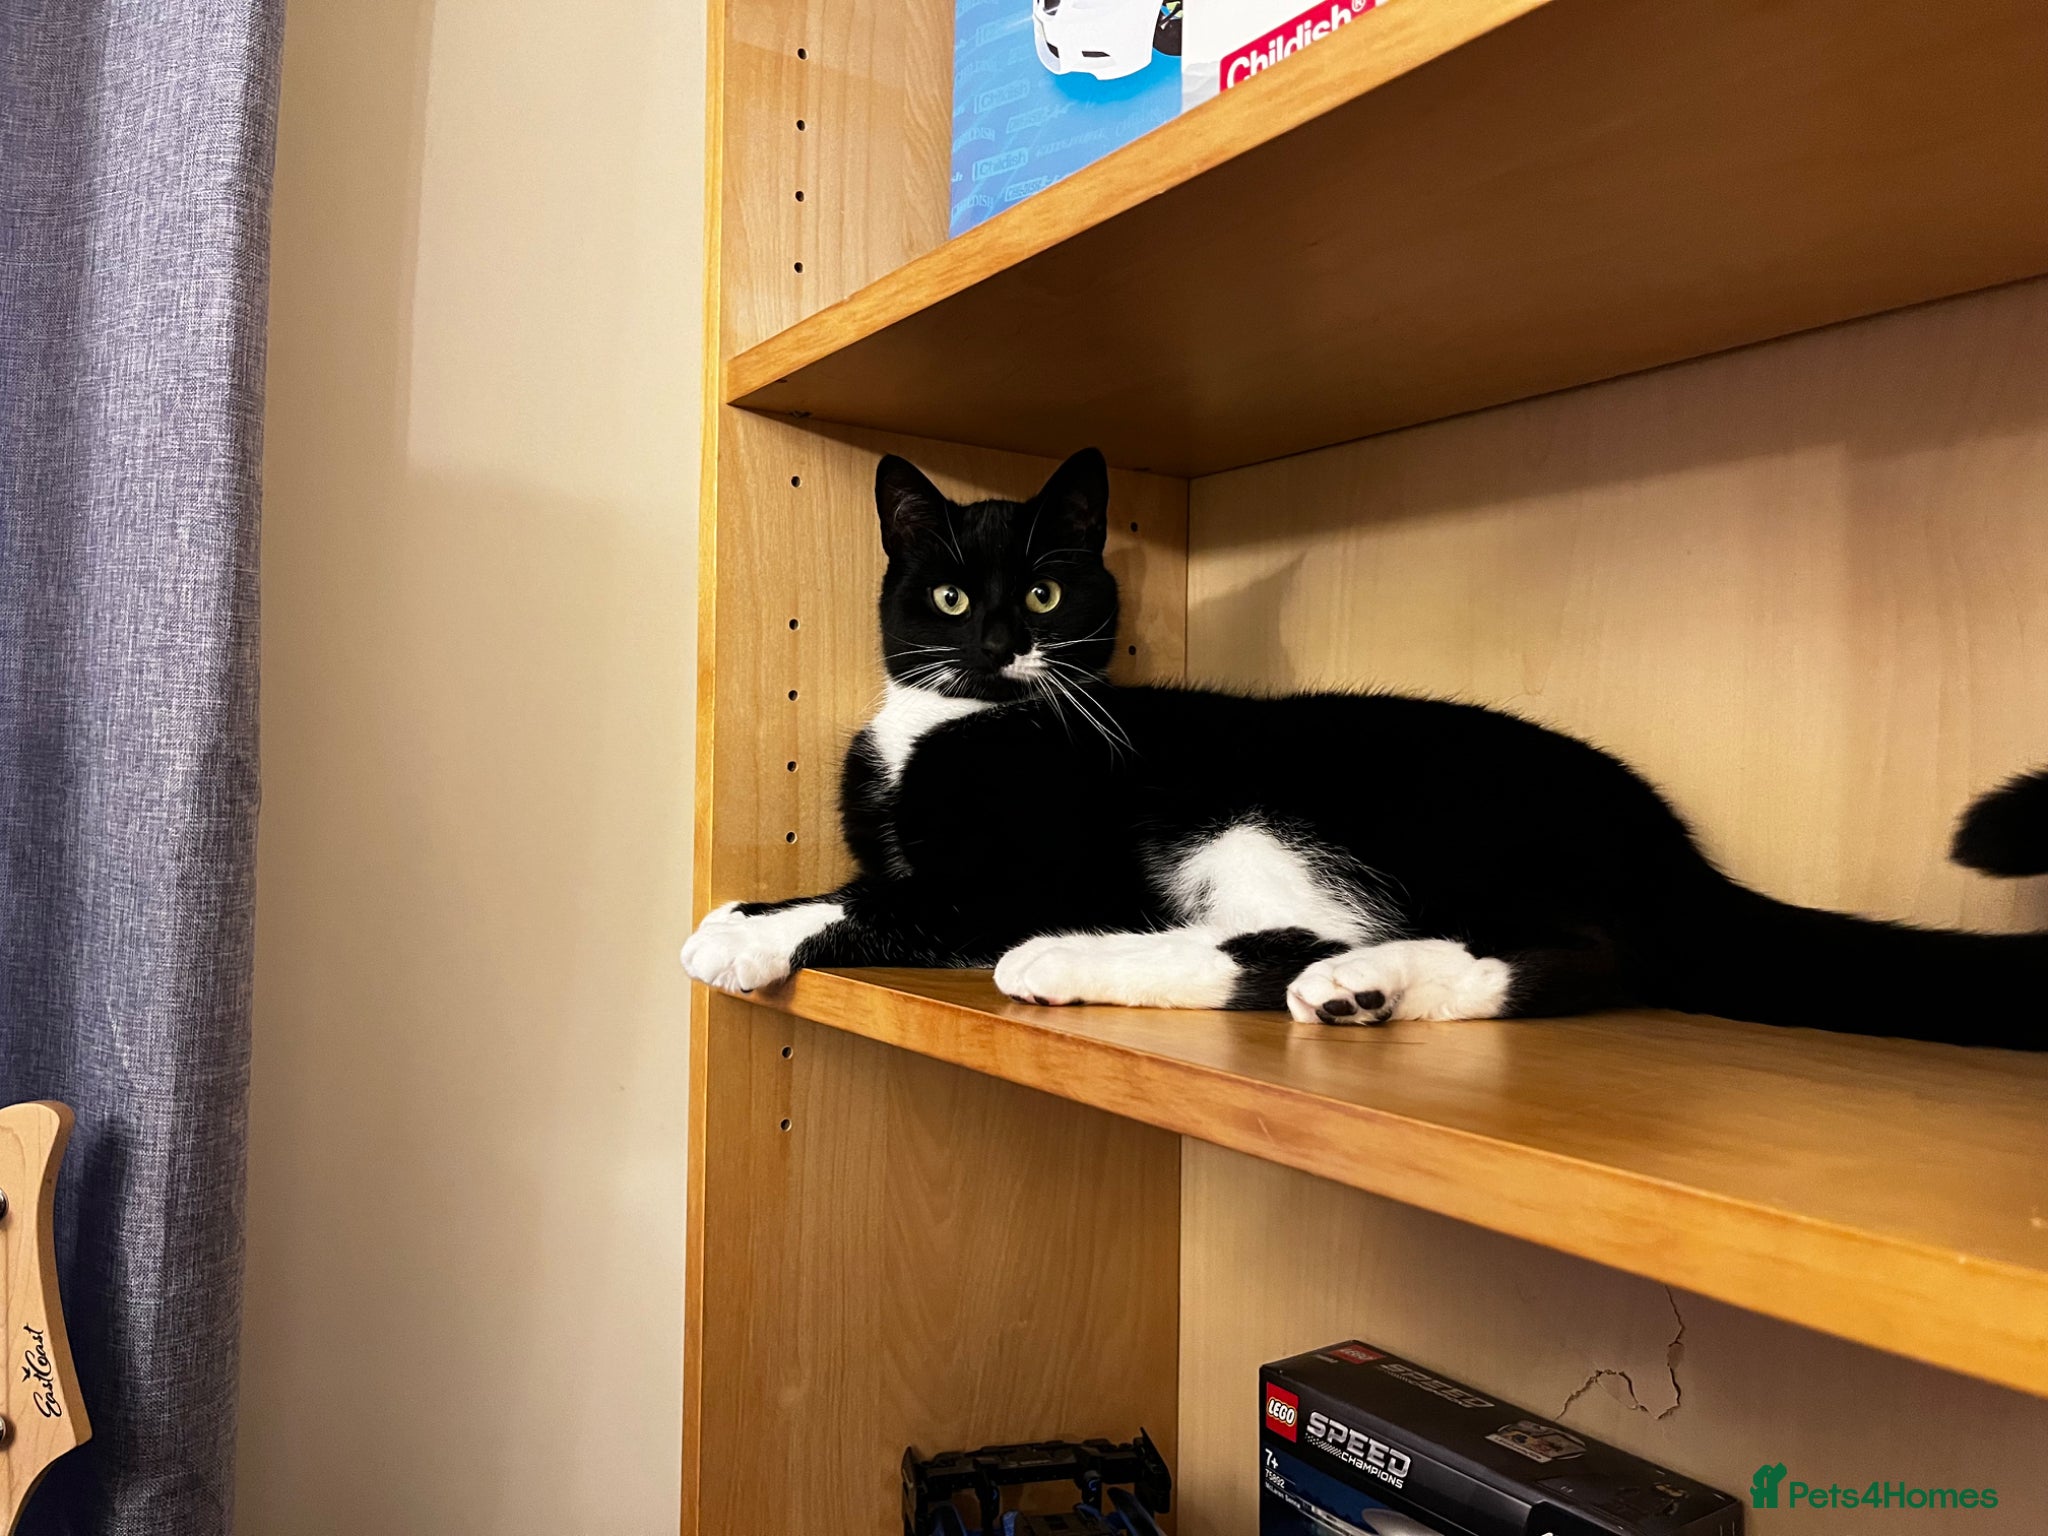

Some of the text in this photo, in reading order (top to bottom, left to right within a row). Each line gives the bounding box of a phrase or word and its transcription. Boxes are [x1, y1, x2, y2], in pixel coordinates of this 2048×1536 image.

[1268, 1398, 1298, 1426] LEGO
[1264, 1448, 1279, 1470] 7+
[1306, 1411, 1413, 1479] SPEED
